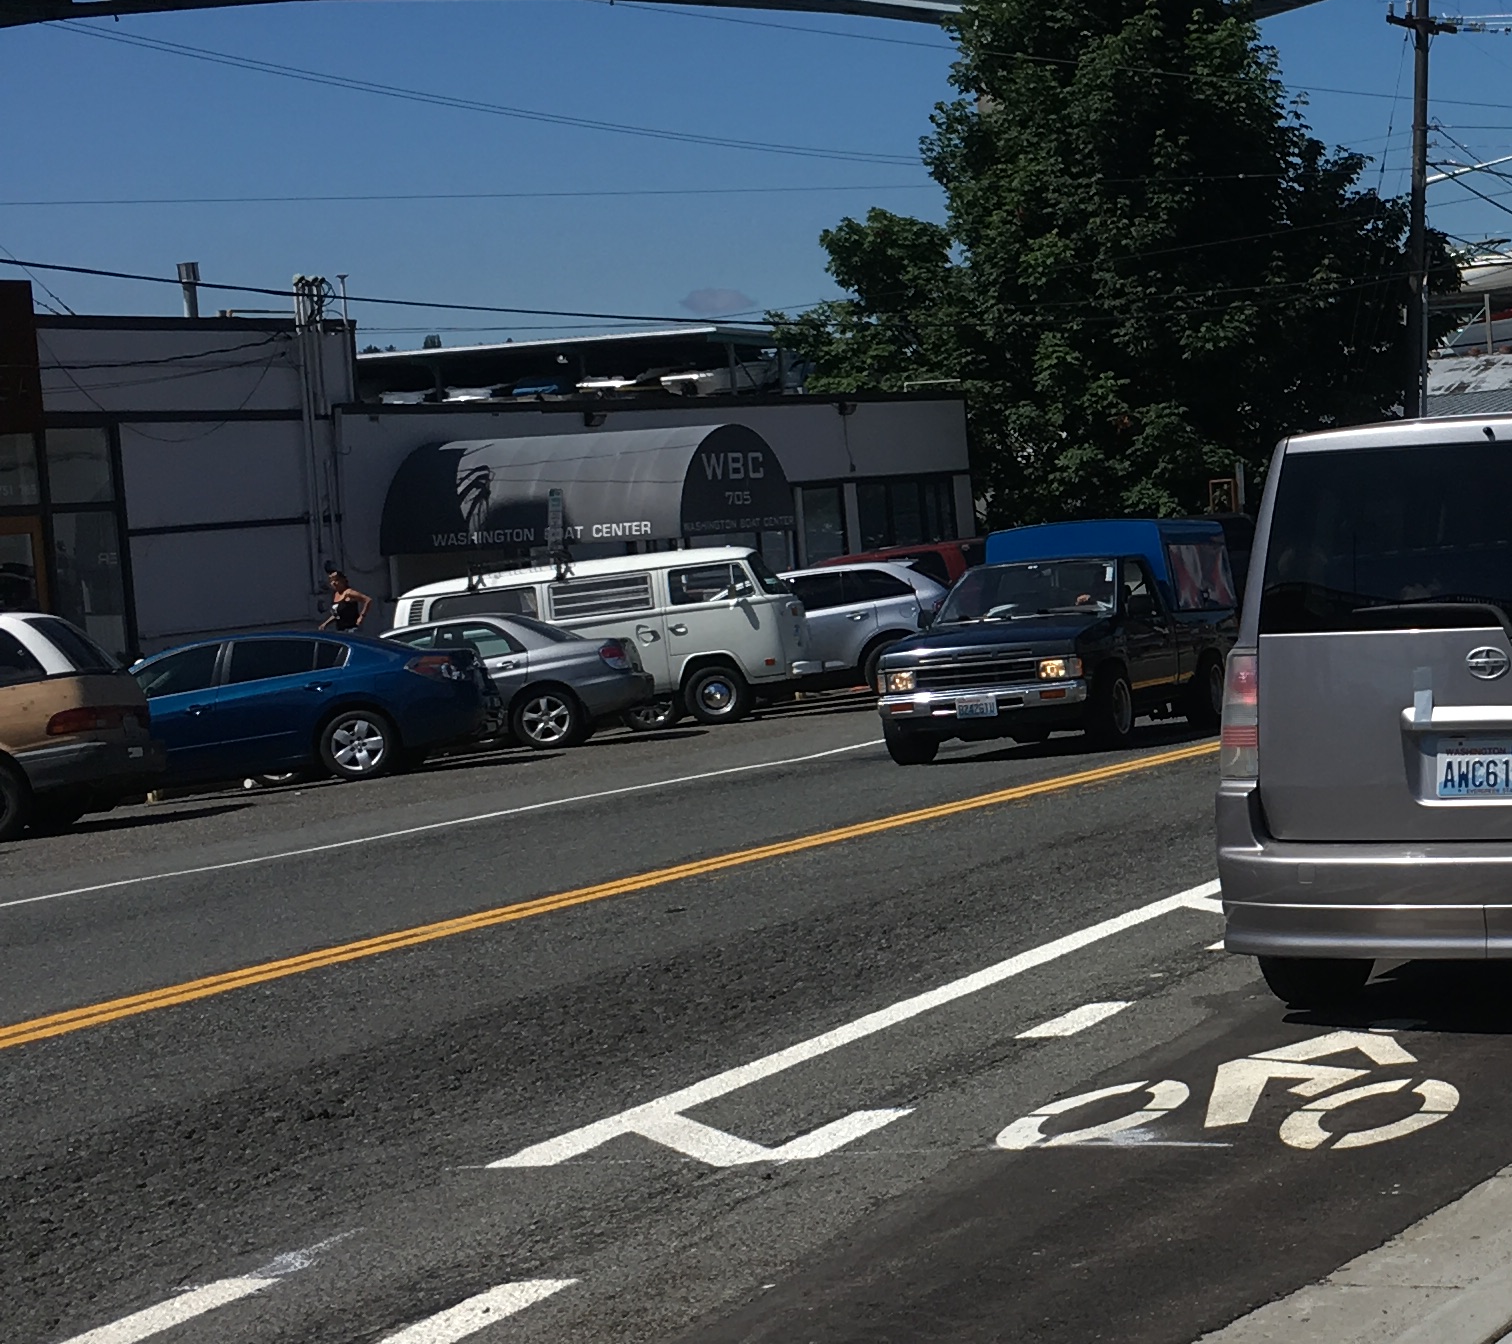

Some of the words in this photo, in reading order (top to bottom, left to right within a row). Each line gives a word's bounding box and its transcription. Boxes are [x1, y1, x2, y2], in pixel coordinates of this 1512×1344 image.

[701, 451, 764, 481] WBC
[725, 491, 752, 505] 705
[683, 519, 737, 531] WASHINGTON
[740, 517, 761, 529] BOAT
[763, 515, 794, 528] CENTER
[432, 528, 535, 547] WASHINGTON
[592, 521, 652, 538] CENTER
[1445, 747, 1506, 756] WASHINGTON
